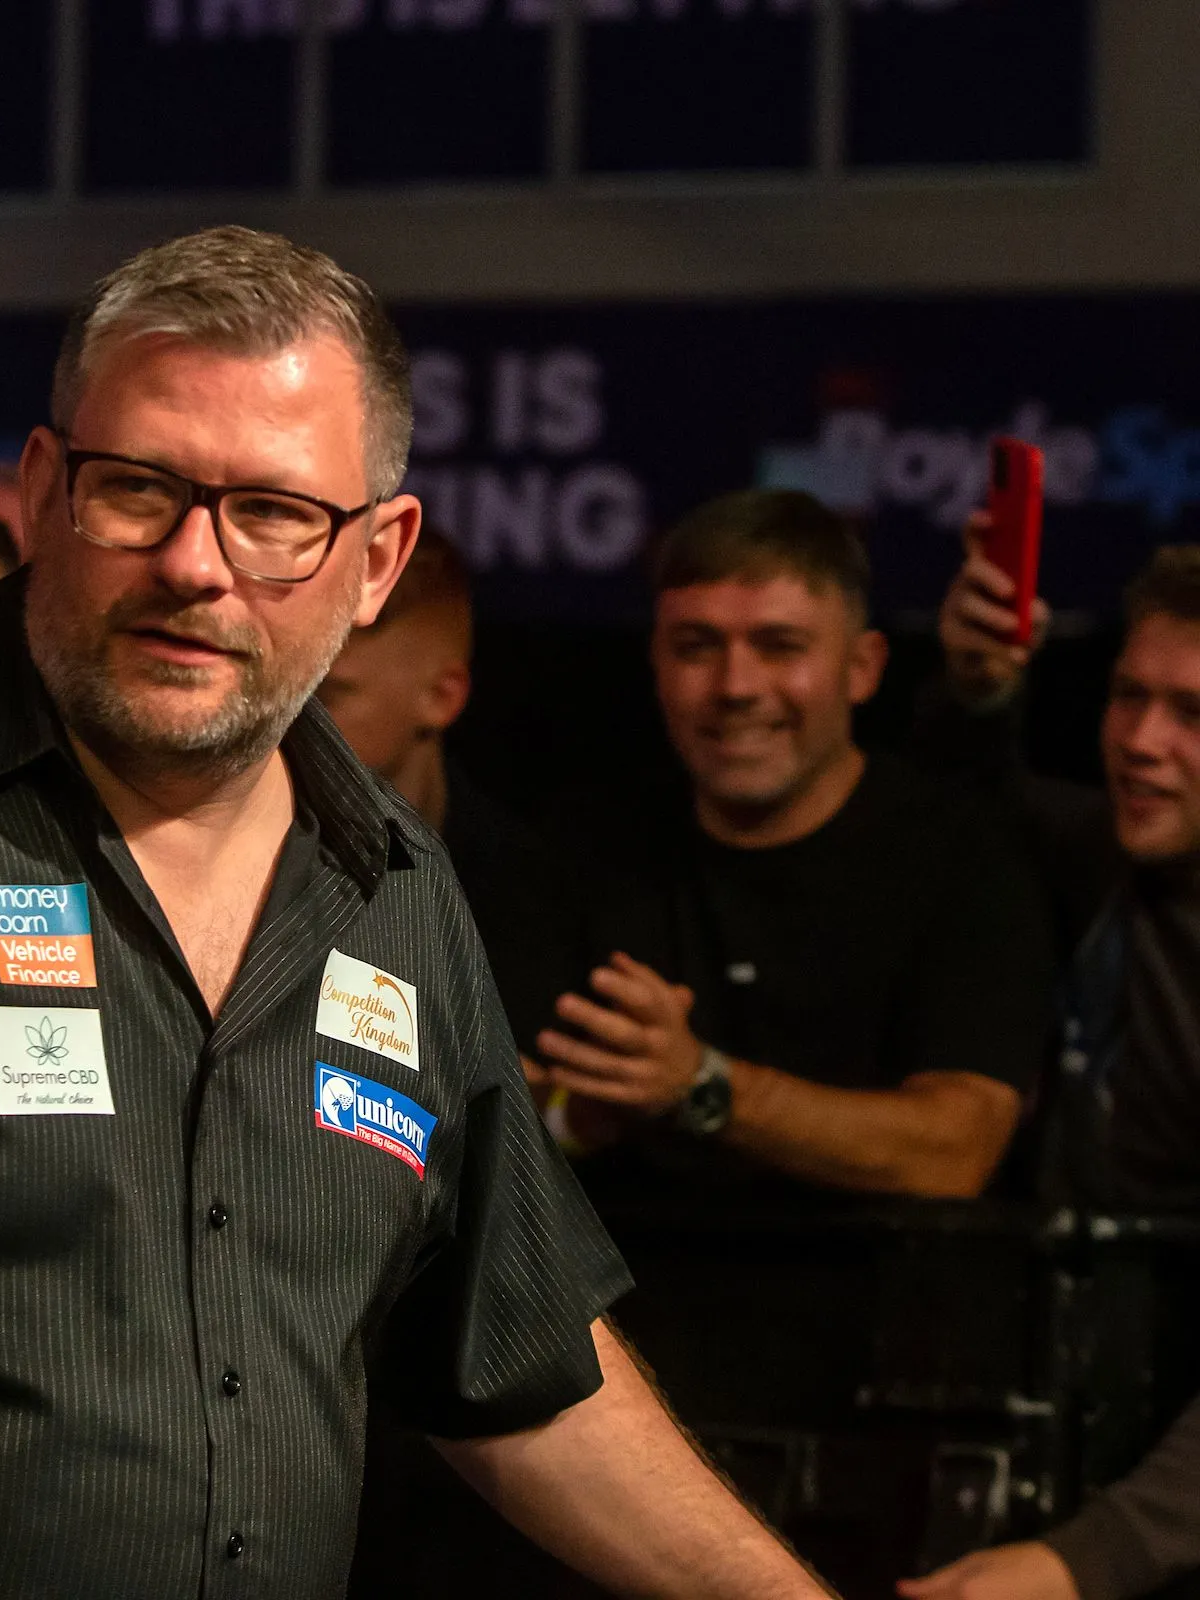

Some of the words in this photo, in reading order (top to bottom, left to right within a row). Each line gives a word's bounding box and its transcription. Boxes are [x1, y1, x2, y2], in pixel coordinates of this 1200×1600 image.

[0, 939, 78, 962] Vehicle
[6, 963, 81, 985] Finance
[322, 974, 397, 1023] Competition
[349, 1011, 411, 1056] Kingdom
[357, 1094, 425, 1153] unicorn
[358, 1127, 371, 1141] The
[372, 1134, 383, 1146] Big
